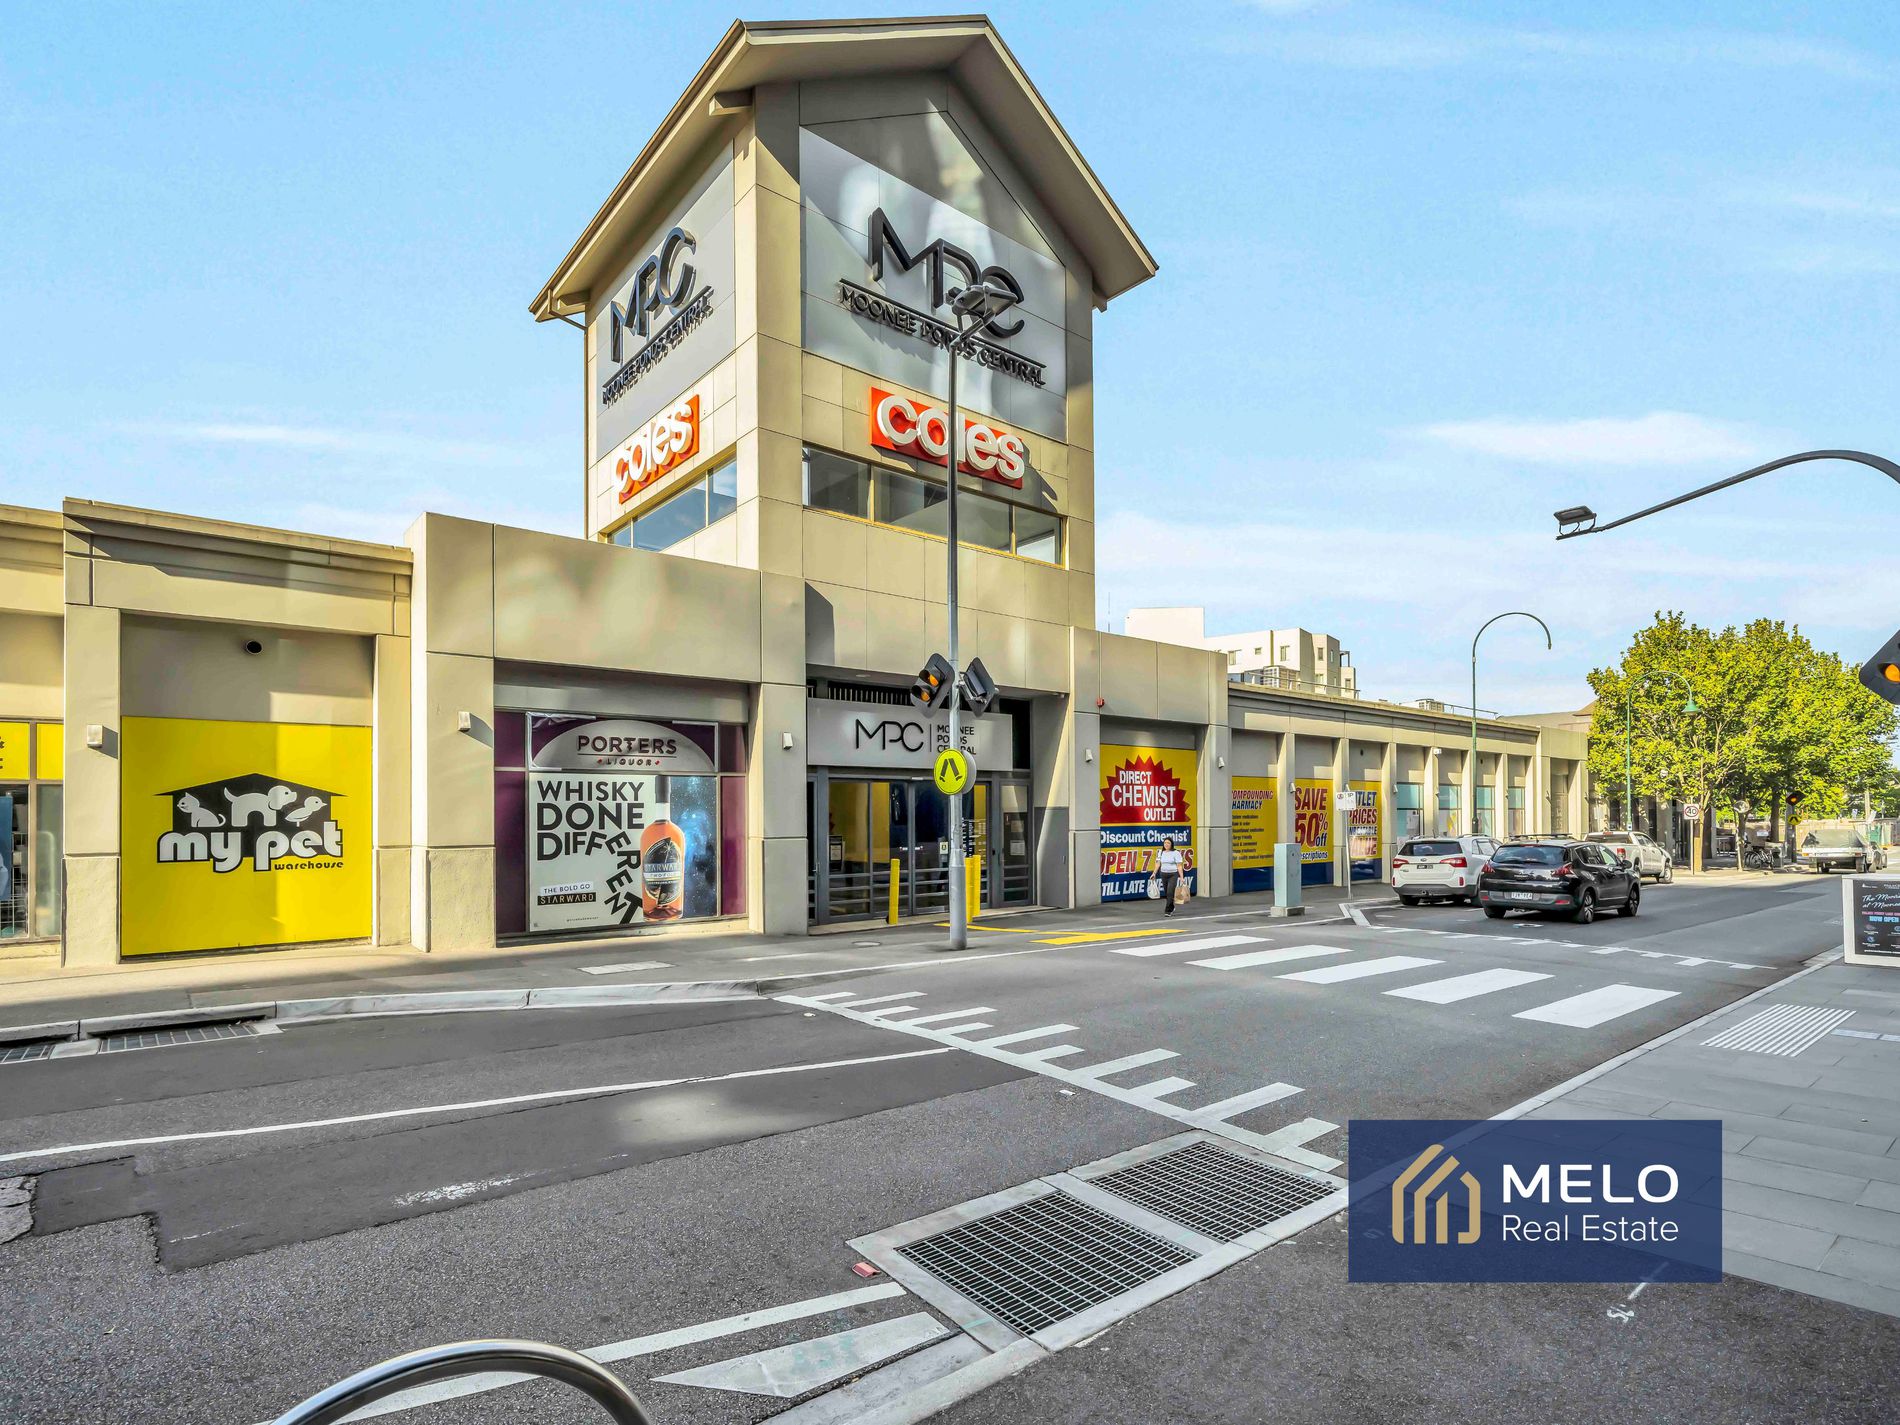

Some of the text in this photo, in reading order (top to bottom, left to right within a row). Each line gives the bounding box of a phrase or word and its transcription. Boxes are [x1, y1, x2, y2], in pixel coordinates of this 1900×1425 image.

[868, 207, 1025, 338] MPC
[611, 227, 696, 363] MPC
[841, 286, 917, 336] MOONEE
[977, 347, 1046, 388] CENTRAL
[602, 295, 713, 405] MOONEE PONDS CENTRAL
[611, 398, 693, 494] coles
[877, 394, 1025, 480] coles
[855, 718, 924, 752] MPC
[937, 724, 975, 735] MONEE
[577, 735, 677, 755] PORTERS
[937, 735, 968, 745] POS
[606, 757, 652, 767] LIQUOR
[1119, 770, 1152, 785] DIRECT
[537, 780, 645, 802] WHISKY
[1111, 784, 1176, 807] CHEMIST
[1232, 790, 1274, 800] OMPOUNDING
[1295, 787, 1328, 811] SAVE
[1355, 791, 1377, 807] TLET
[1143, 808, 1176, 821] OUTLET
[1232, 801, 1263, 810] HARMACY
[537, 802, 645, 831] DONE
[157, 820, 343, 873] my pet
[1100, 831, 1146, 844] Discount
[1316, 833, 1328, 847] off
[1141, 848, 1153, 874] 7
[1301, 851, 1328, 860] scriptions
[274, 861, 344, 871] warehouse
[537, 830, 644, 925] DIFFERENT
[1102, 882, 1120, 896] TILL
[1123, 880, 1145, 895] LATE
[540, 893, 594, 904] STARWARD
